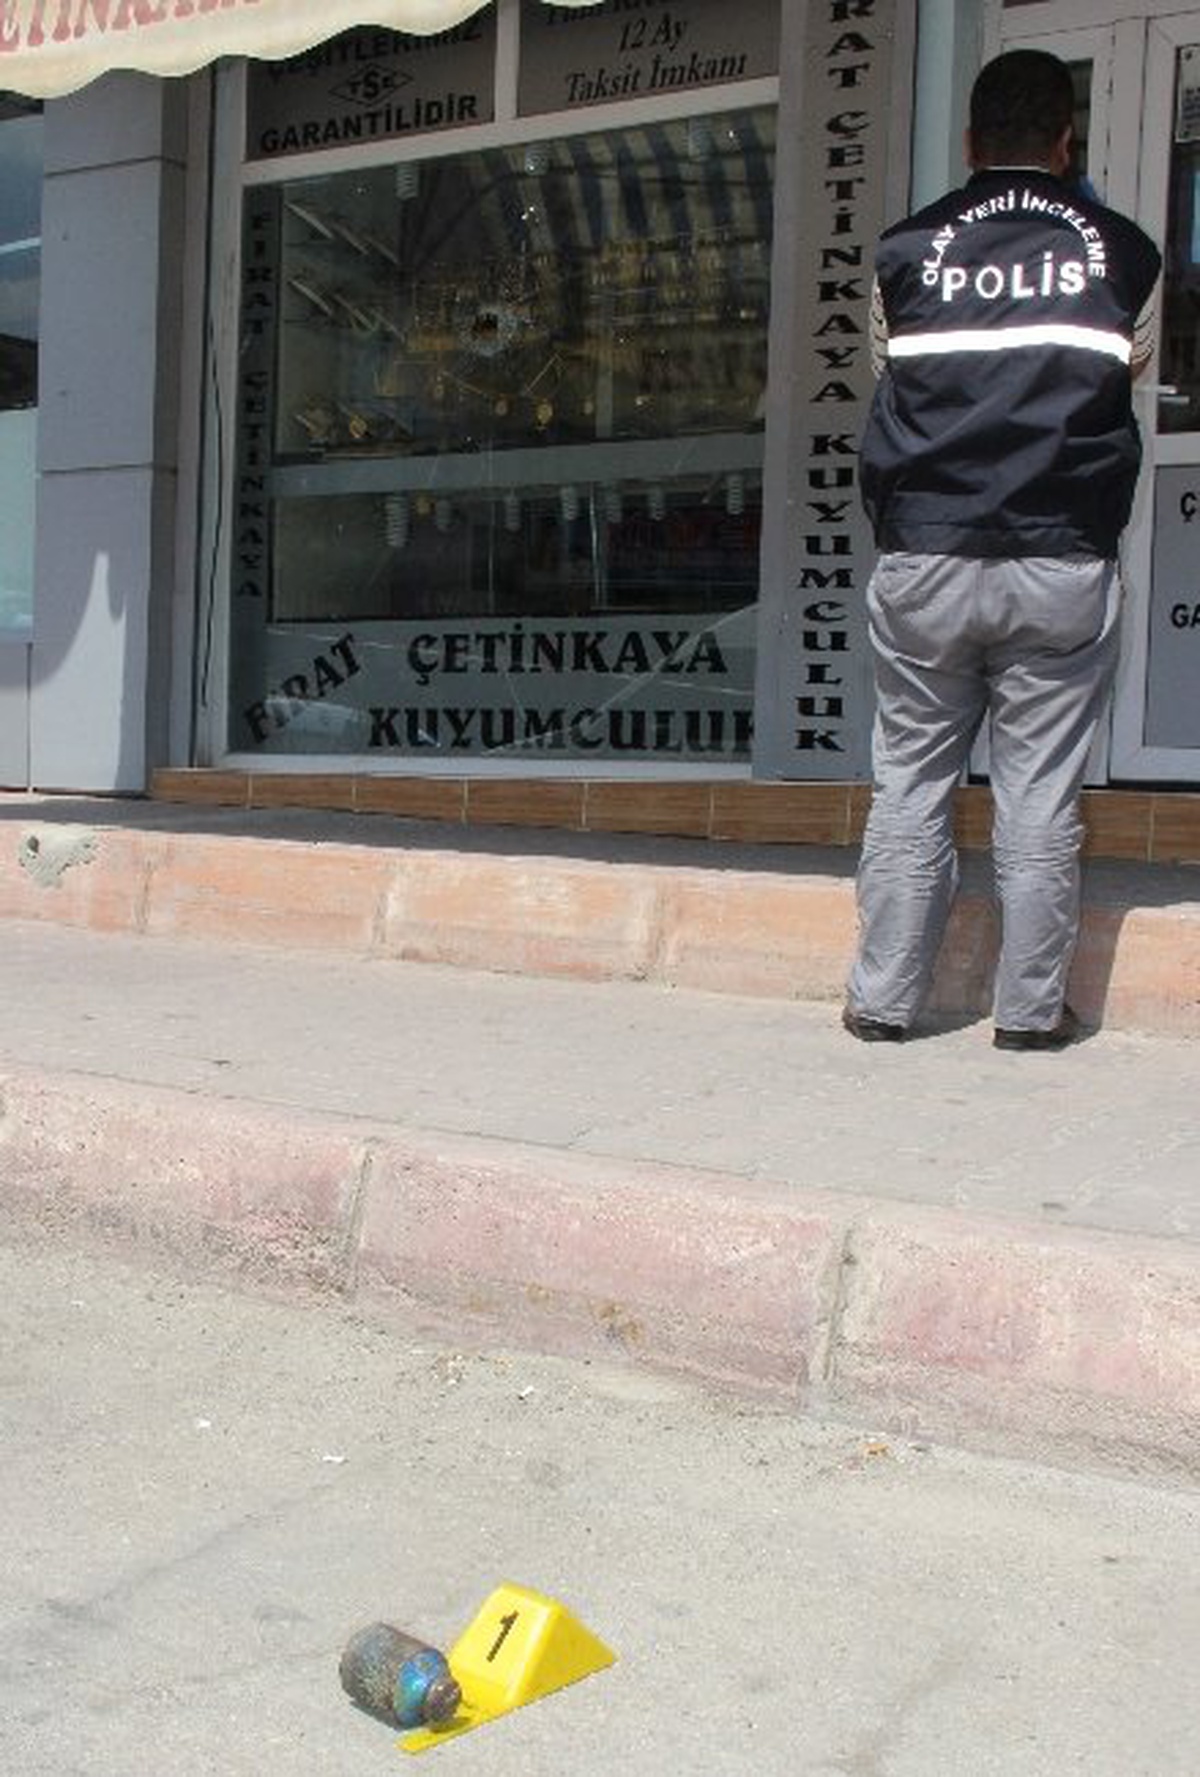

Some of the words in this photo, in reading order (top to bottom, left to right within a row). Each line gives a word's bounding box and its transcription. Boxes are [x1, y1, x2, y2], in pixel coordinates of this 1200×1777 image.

[619, 17, 647, 52] 12
[649, 12, 689, 51] Ay
[567, 62, 641, 102] Taksit
[648, 52, 748, 89] İmkanı
[260, 93, 477, 154] GARANTİLİDİR
[808, 110, 871, 402] ÇETİNKAYA
[922, 223, 956, 286] OLAY
[958, 189, 1015, 224] YERİ
[1021, 188, 1107, 279] İNCELEME
[941, 251, 1086, 302] POLİS
[795, 433, 858, 752] KUYUMCULUK
[407, 623, 727, 686] ÇETİNKAYA
[486, 1610, 520, 1663] 1
